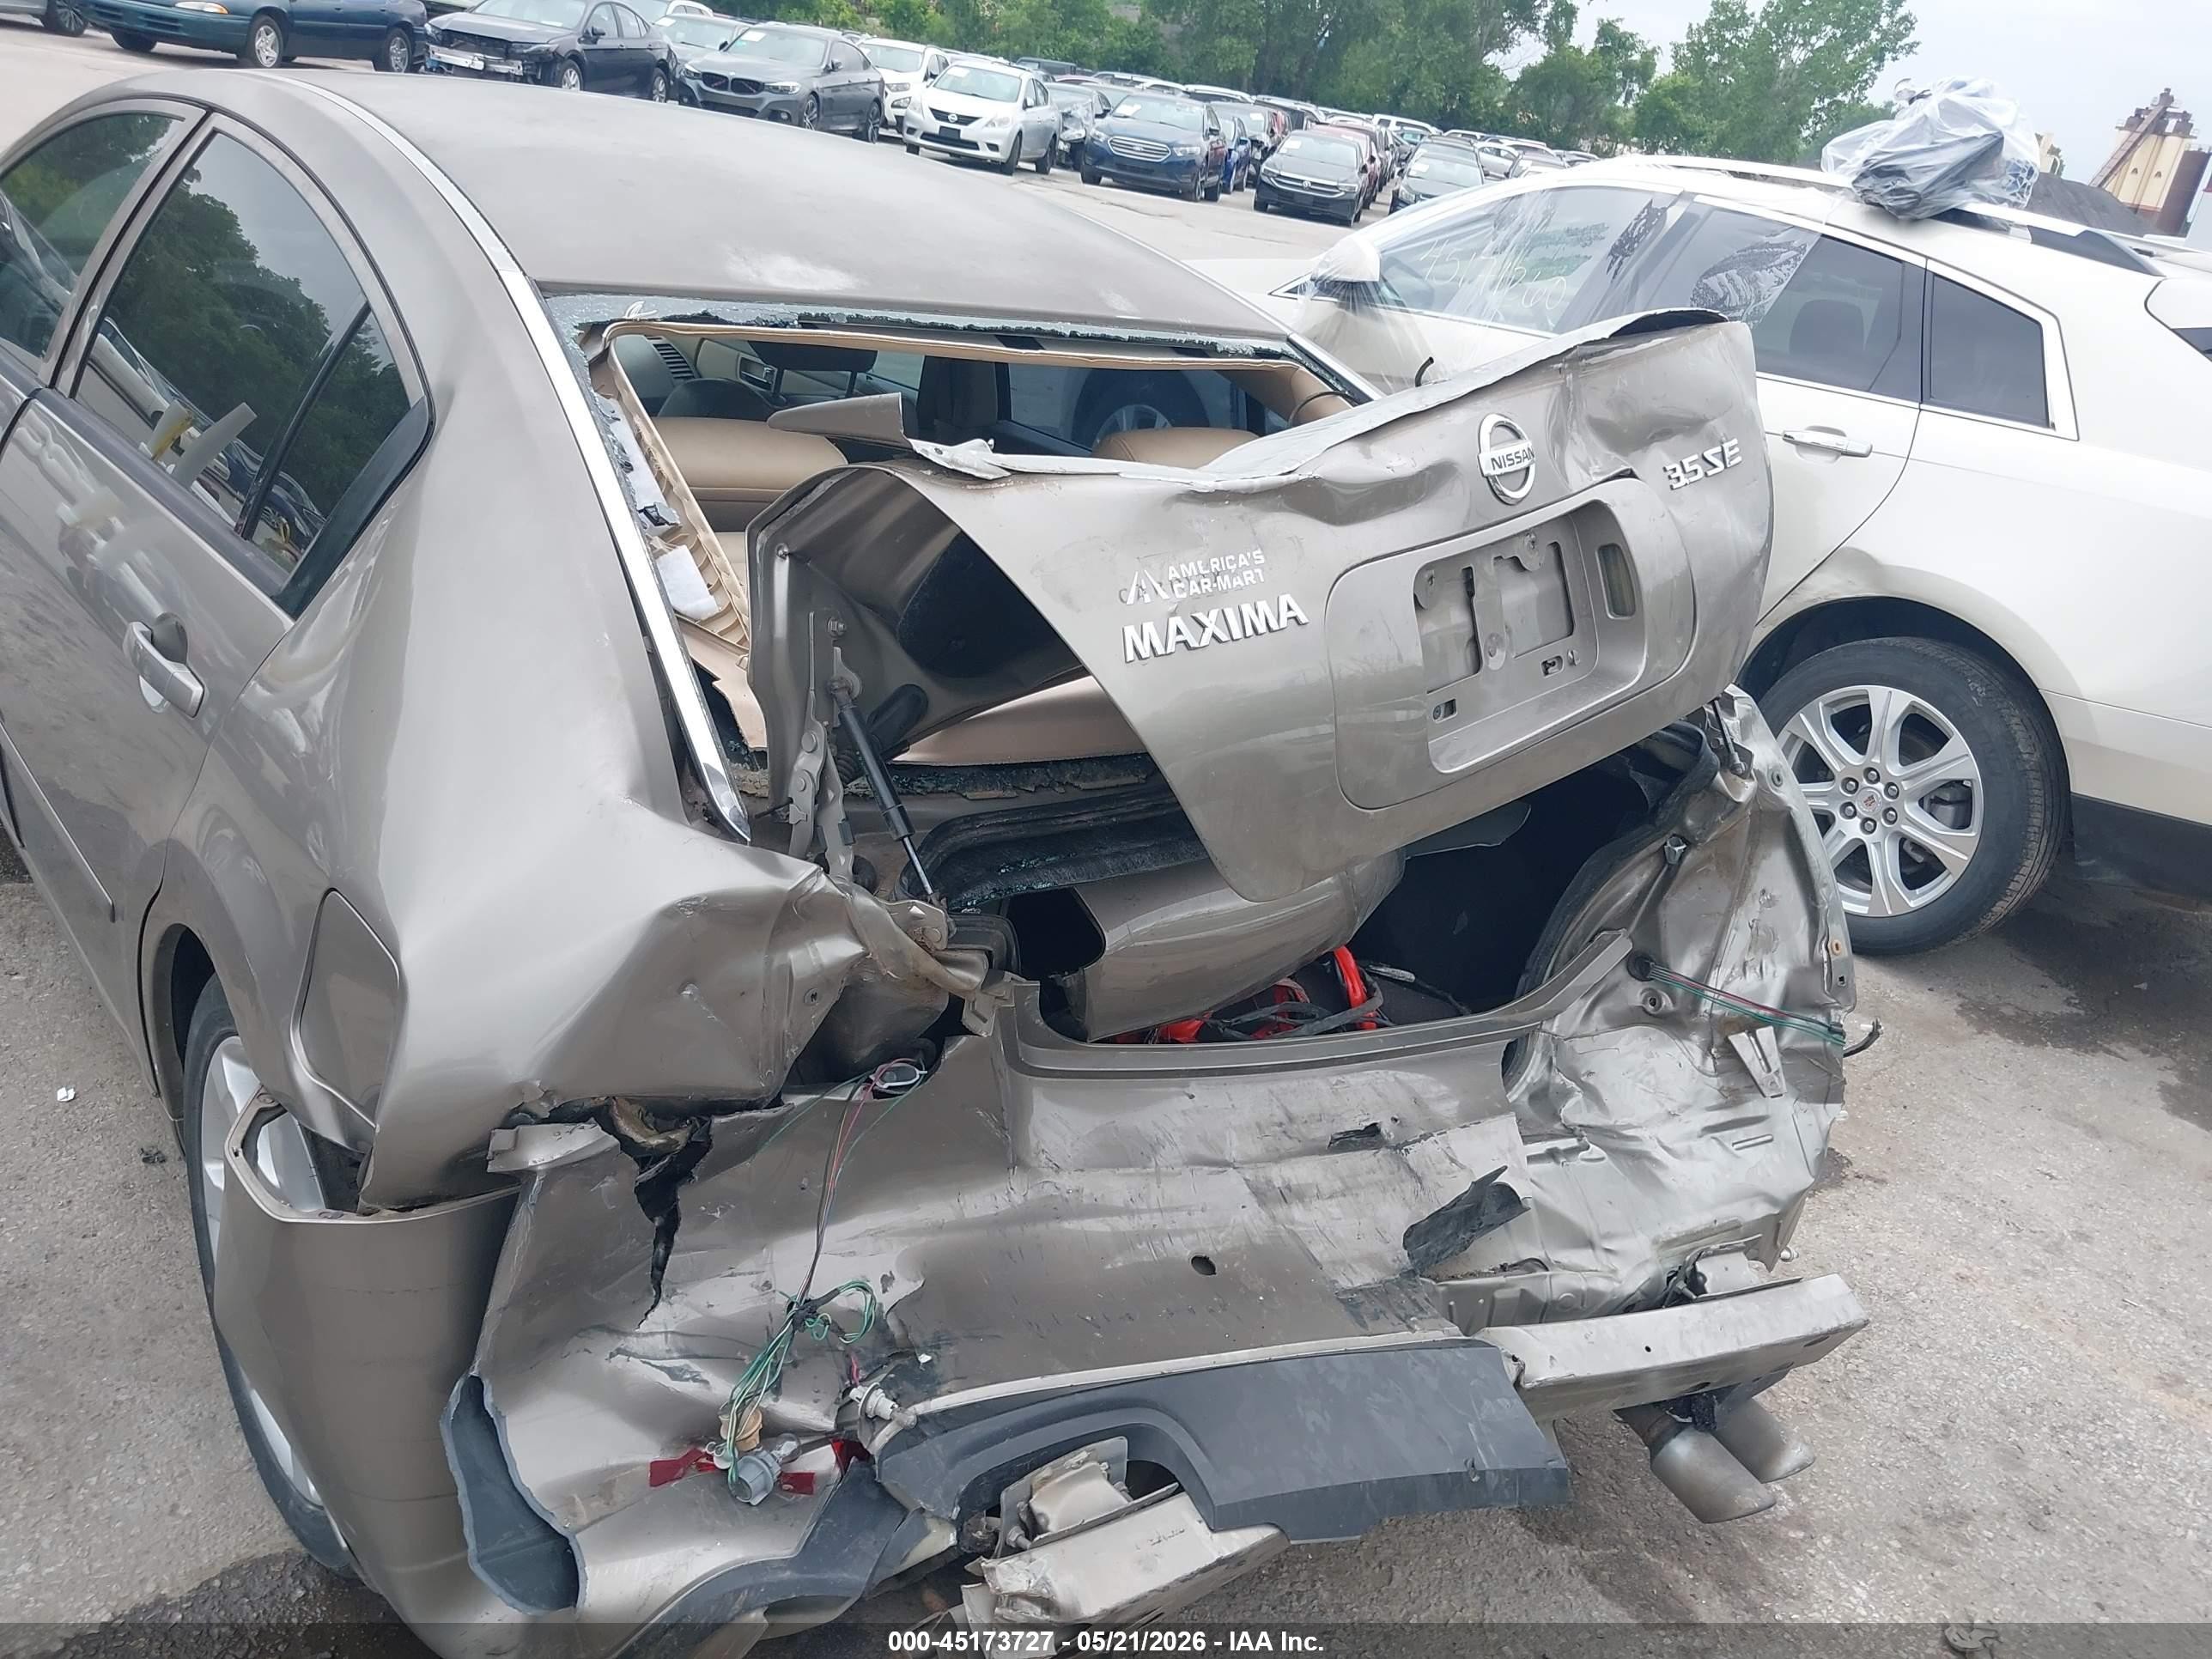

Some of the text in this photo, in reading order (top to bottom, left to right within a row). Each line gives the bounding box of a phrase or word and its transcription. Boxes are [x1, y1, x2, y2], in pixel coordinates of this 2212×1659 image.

[1491, 446, 1535, 471] NISSAN
[1167, 547, 1266, 581] AMERICA'S
[1173, 568, 1266, 599] CAR-MART
[1121, 592, 1310, 664] MAXIMA
